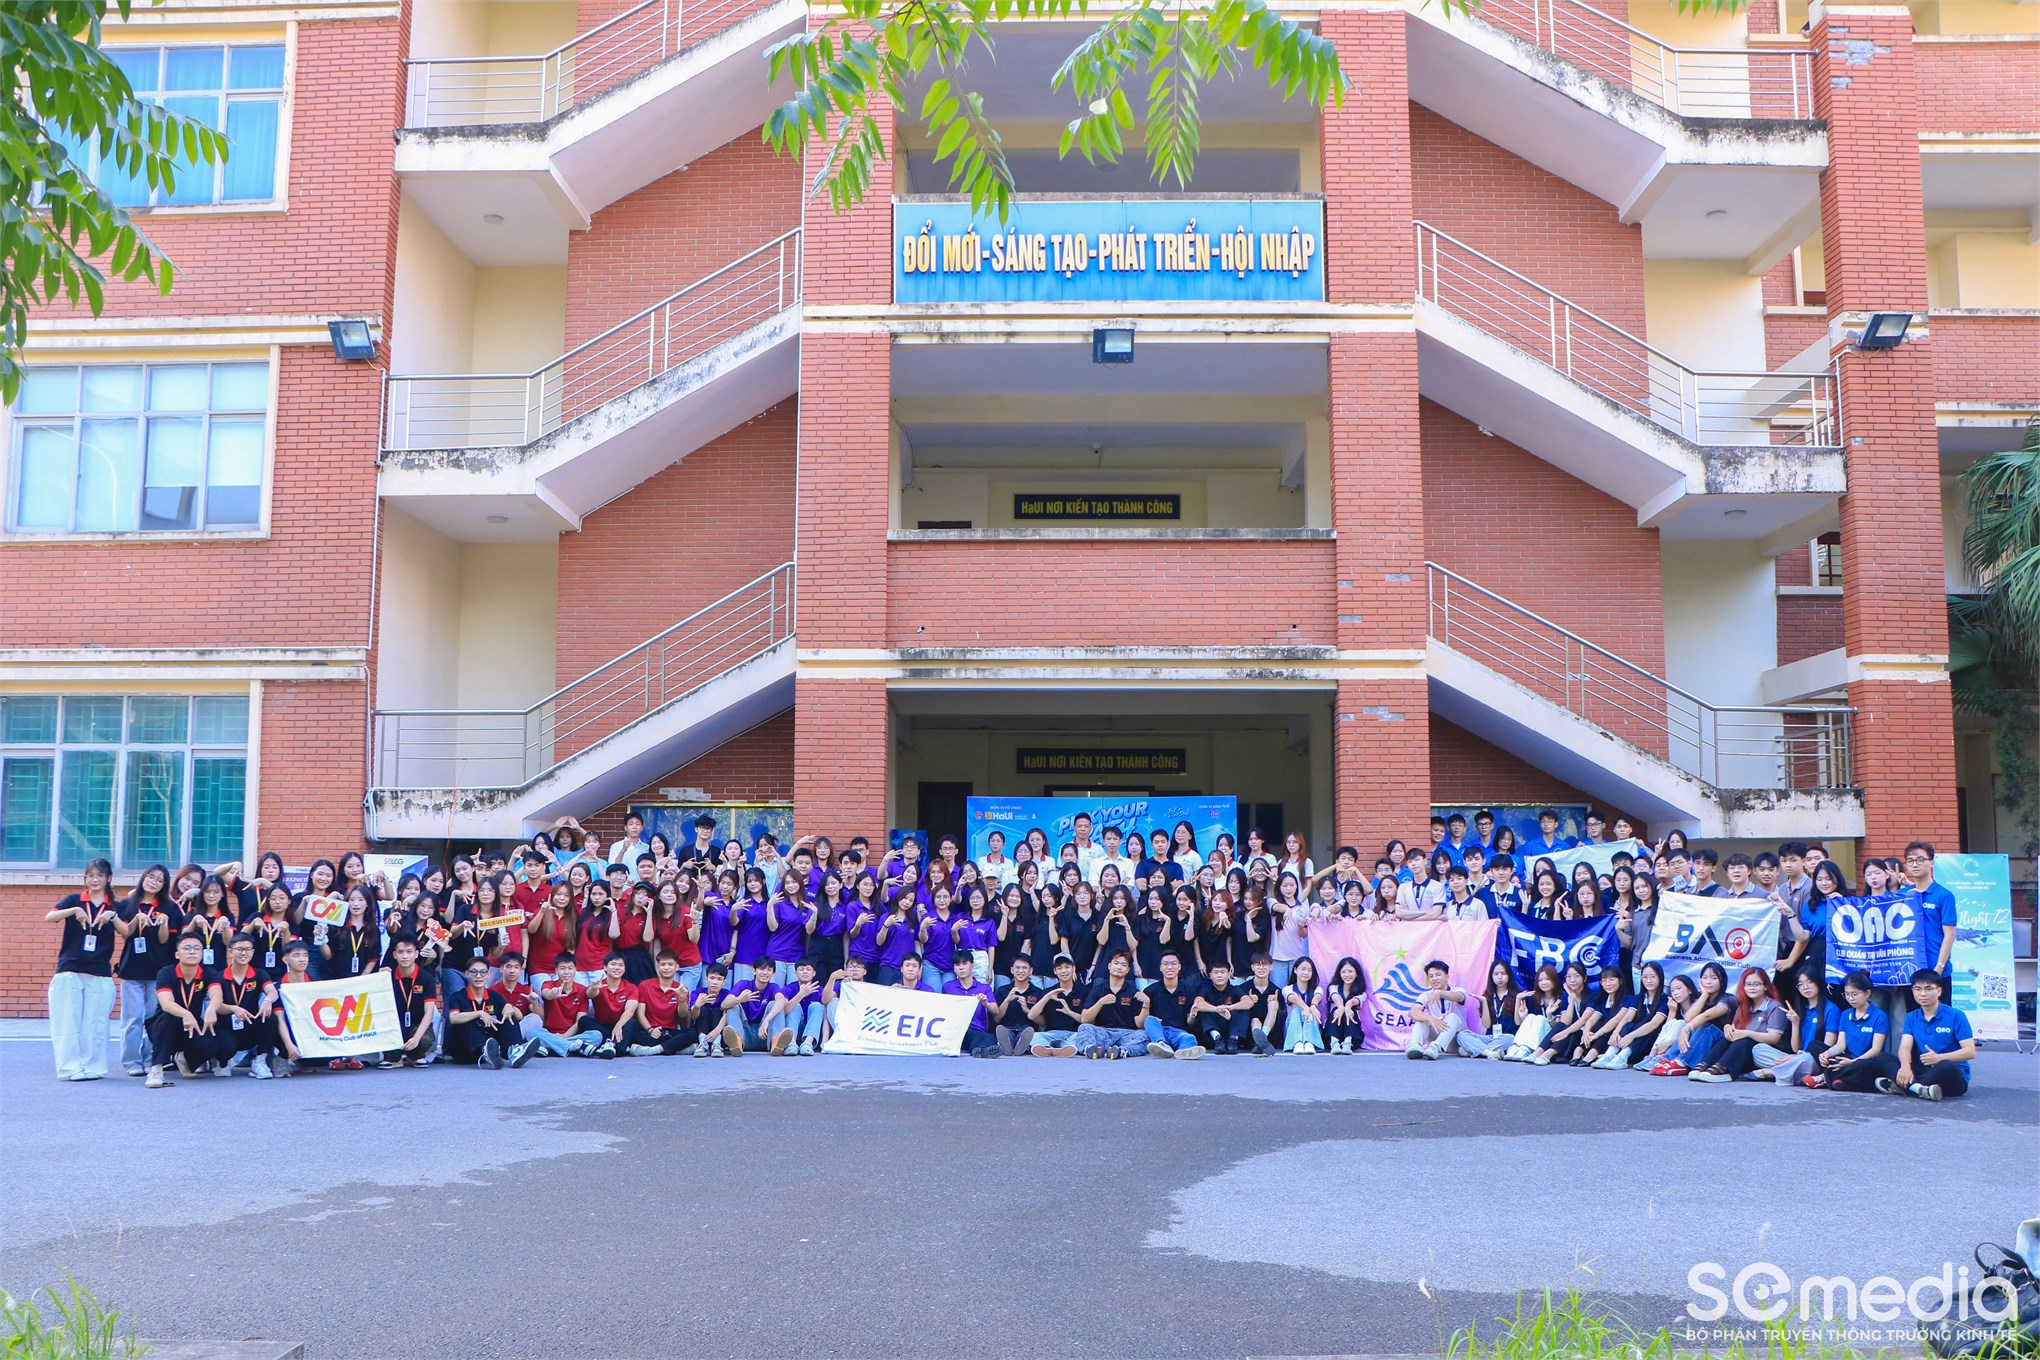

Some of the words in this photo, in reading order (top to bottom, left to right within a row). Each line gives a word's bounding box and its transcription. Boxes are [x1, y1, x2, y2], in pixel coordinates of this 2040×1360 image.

[903, 219, 937, 273] ĐỔI
[1260, 225, 1316, 279] NHẬP
[1021, 501, 1043, 514] HaUI
[1091, 501, 1110, 516] TẠO
[1112, 499, 1144, 514] THÀNH
[1147, 499, 1173, 514] CÔNG
[1095, 755, 1113, 771] TẠO
[1151, 753, 1178, 769] CÔNG
[993, 811, 1013, 820] HaUI
[1057, 810, 1099, 837] PIK
[1101, 801, 1149, 823] YOUR
[479, 915, 523, 928] RECRUITMENT
[1831, 902, 1916, 944] OAC
[1508, 928, 1604, 976] FBC
[1887, 946, 1914, 957] PHÒNG
[896, 1014, 946, 1038] EIC
